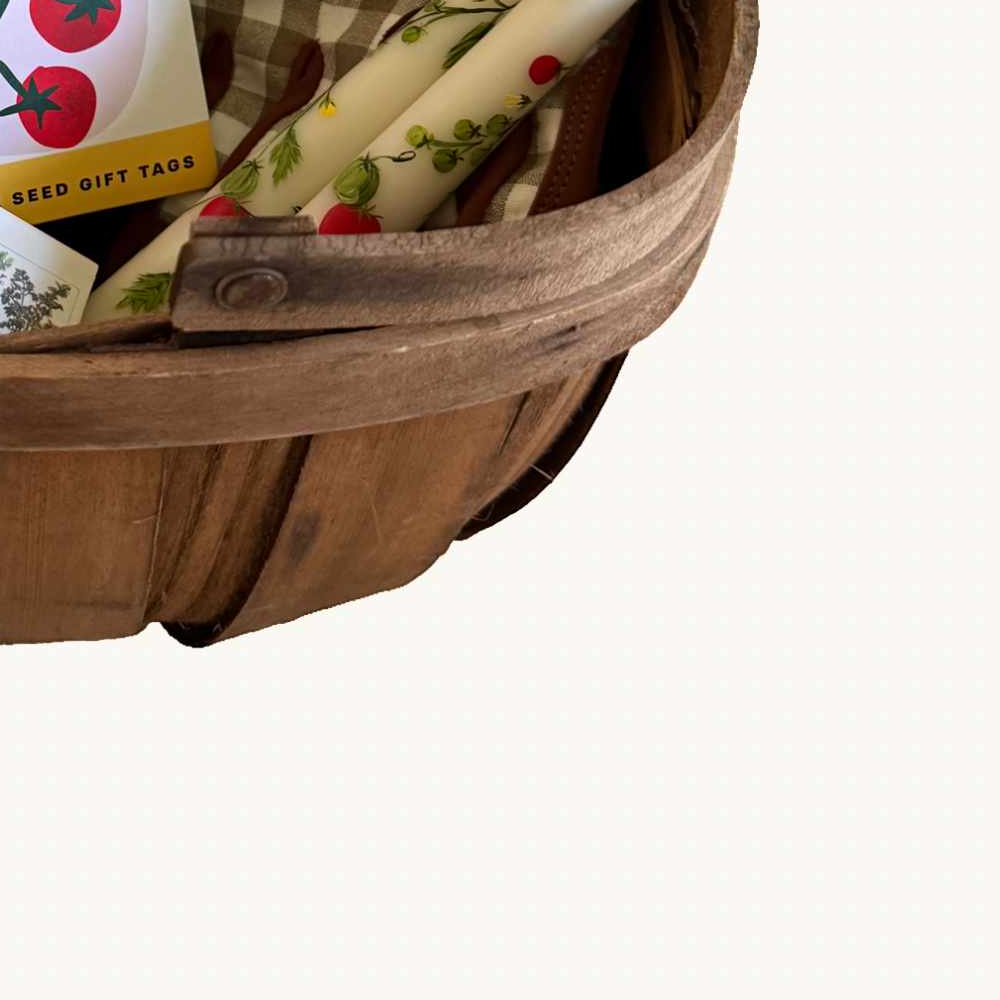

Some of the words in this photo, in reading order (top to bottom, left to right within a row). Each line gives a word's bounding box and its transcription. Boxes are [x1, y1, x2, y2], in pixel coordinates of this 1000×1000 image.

[11, 182, 69, 206] SEED
[79, 169, 129, 192] GIFT
[138, 155, 196, 179] TAGS
